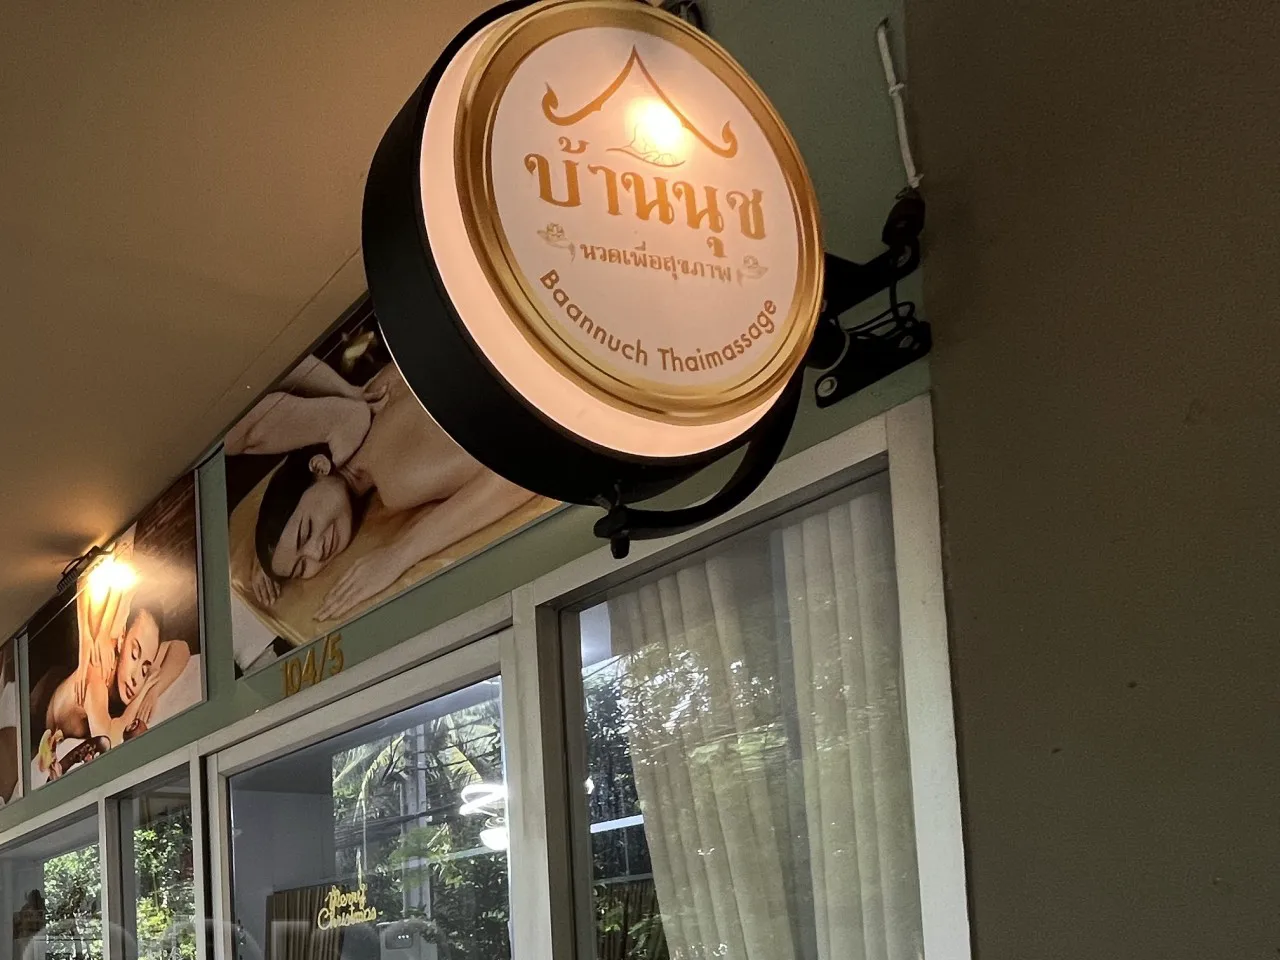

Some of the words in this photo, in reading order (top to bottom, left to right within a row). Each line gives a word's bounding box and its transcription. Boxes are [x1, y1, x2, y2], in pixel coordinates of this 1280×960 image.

[524, 136, 767, 258] บ้านนุช
[580, 241, 731, 282] นวดเพื่อสุขภาพ
[540, 268, 648, 367] Baannuch
[658, 298, 777, 373] Thaimassage
[283, 632, 344, 697] 104/5
[325, 884, 367, 909] Merry
